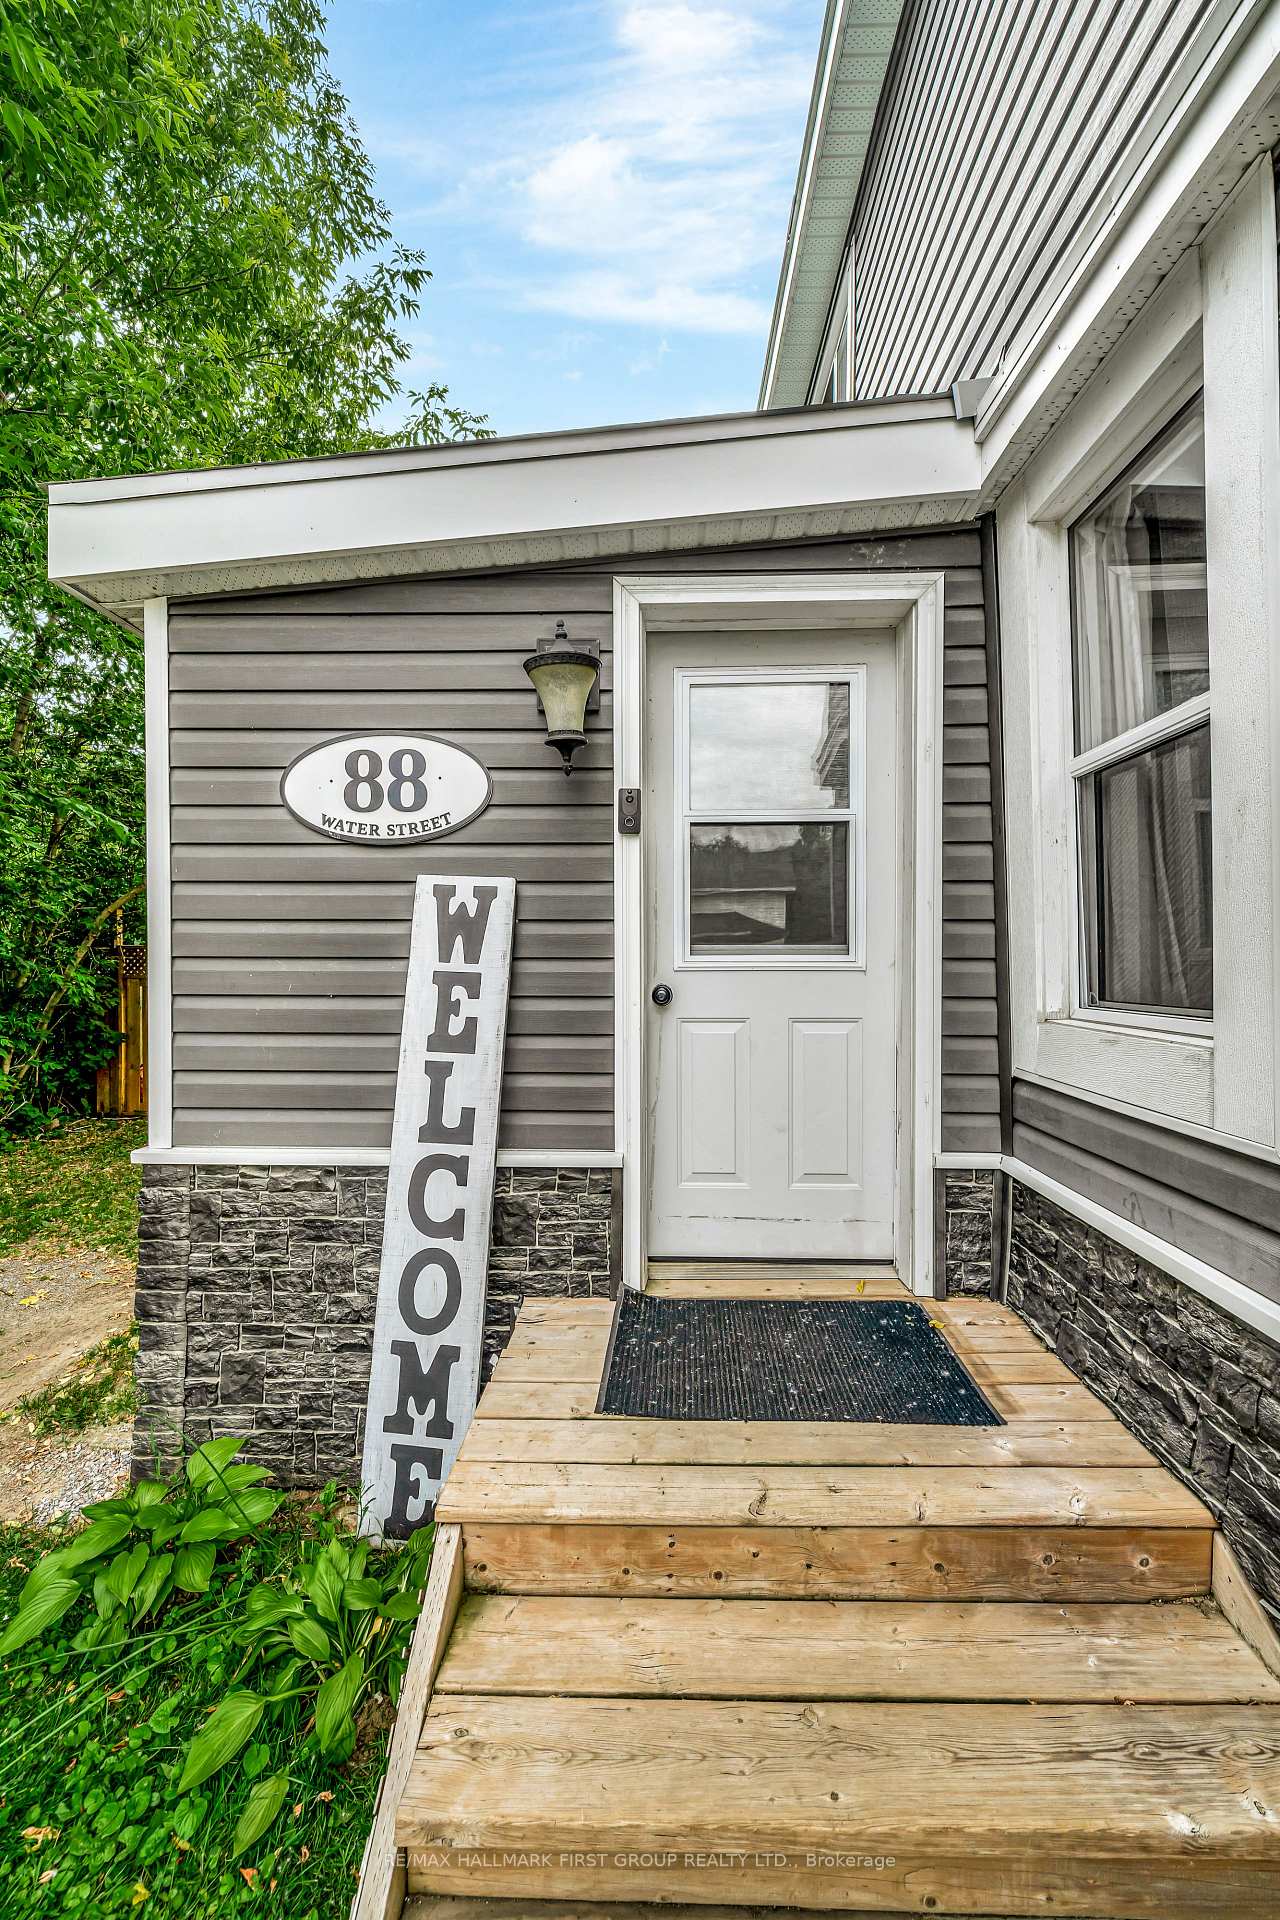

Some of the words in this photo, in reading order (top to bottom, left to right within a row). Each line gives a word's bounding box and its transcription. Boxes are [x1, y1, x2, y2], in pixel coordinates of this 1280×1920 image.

[343, 749, 428, 813] 88
[320, 813, 381, 837] WATER
[386, 812, 452, 836] STREET
[382, 883, 498, 1541] WELCOME
